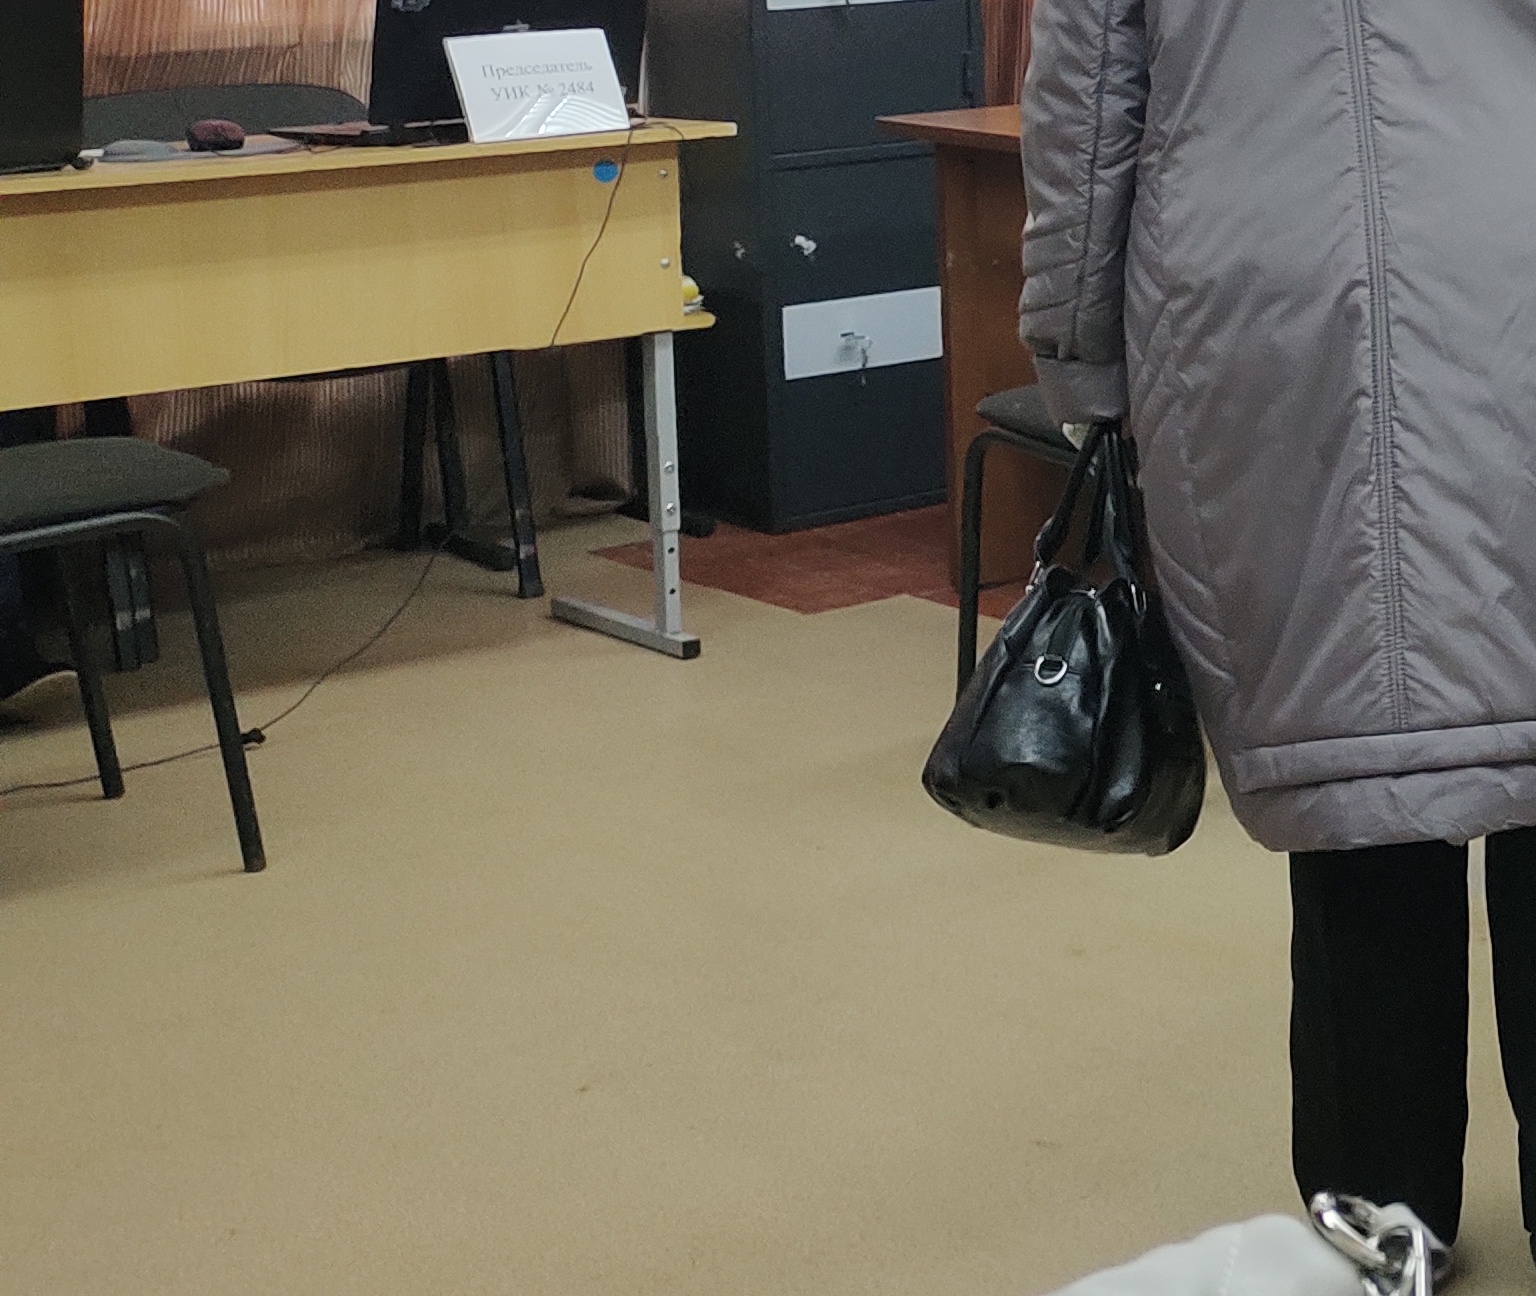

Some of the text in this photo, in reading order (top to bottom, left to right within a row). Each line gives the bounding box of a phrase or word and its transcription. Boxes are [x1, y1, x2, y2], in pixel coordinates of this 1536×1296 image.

[481, 61, 593, 80] Председатель
[490, 80, 595, 102] УИК № 2484
